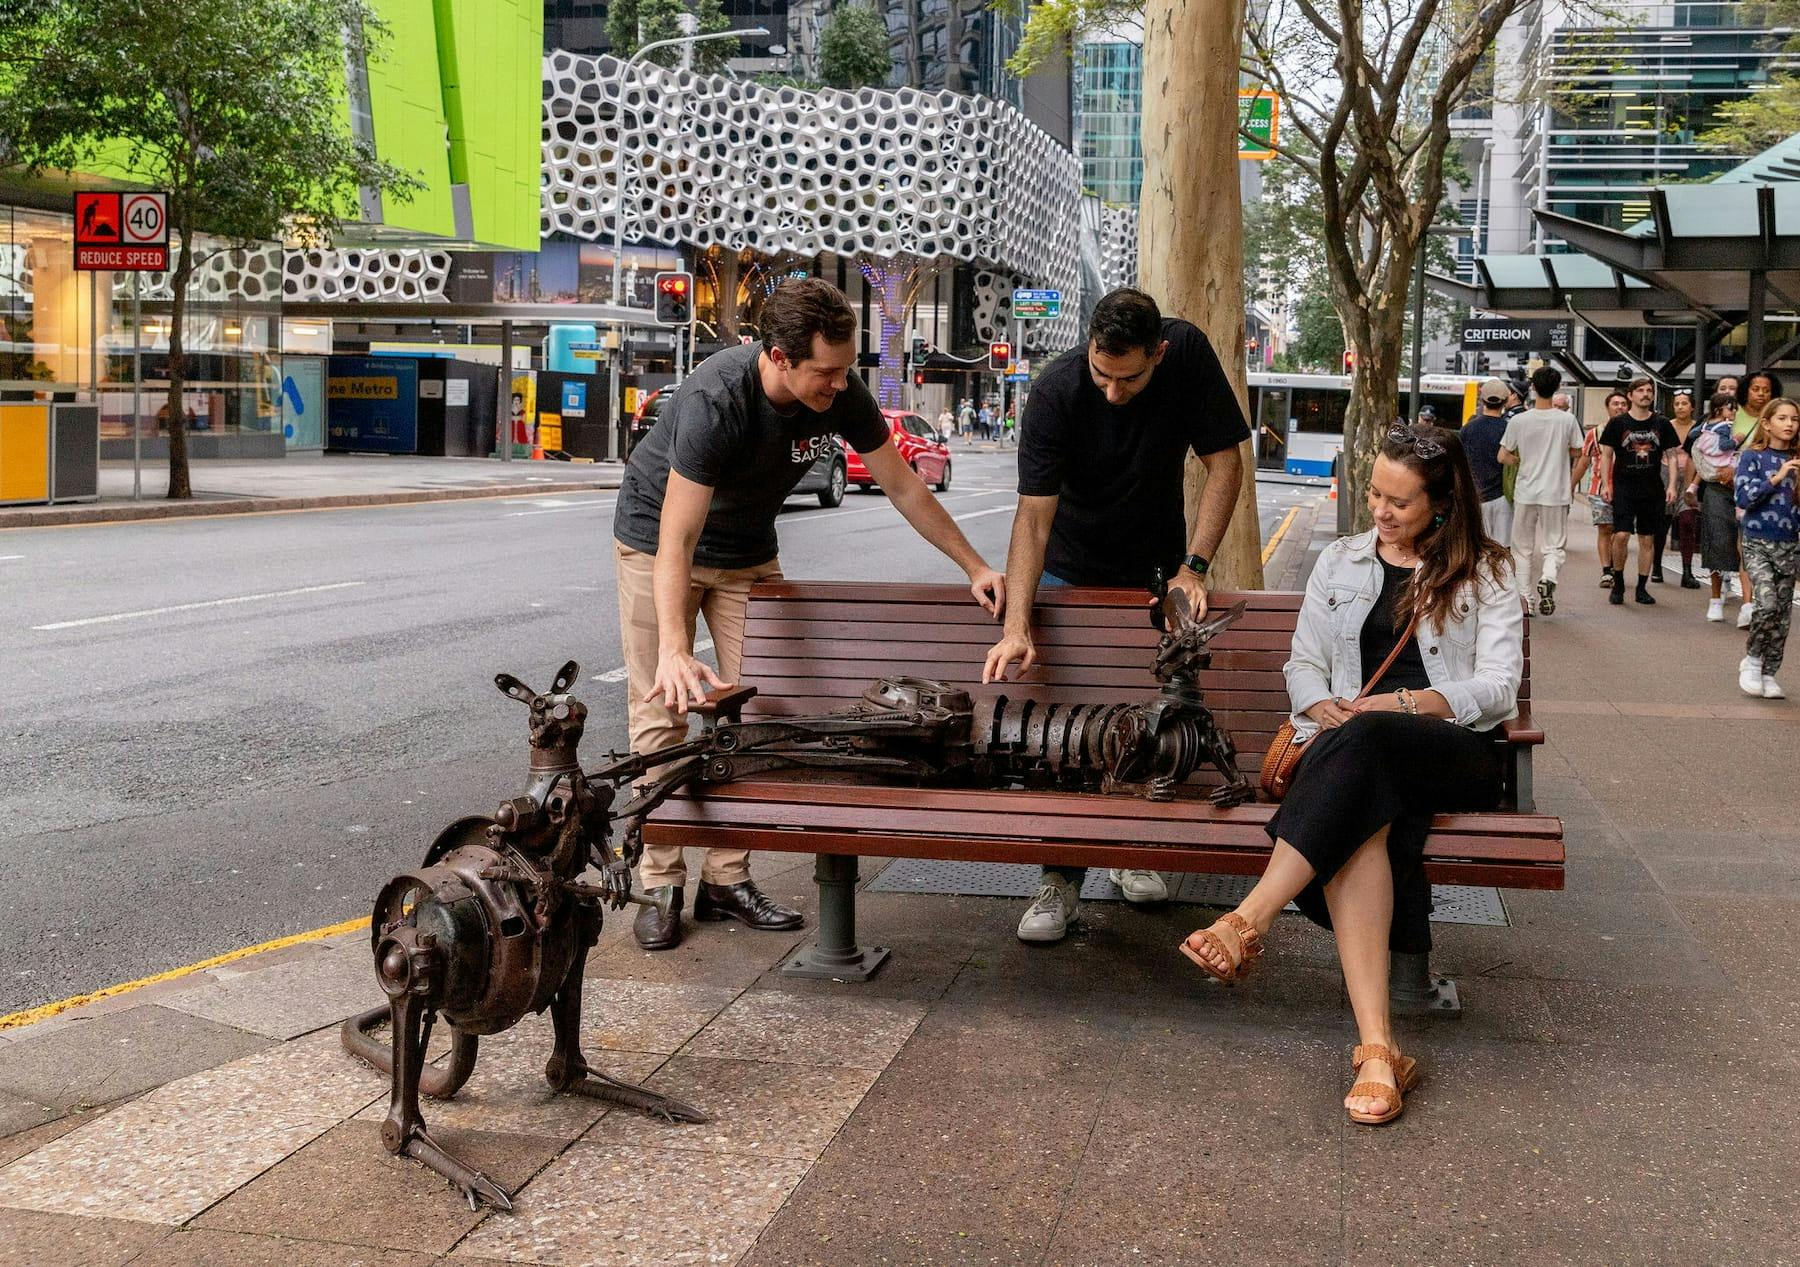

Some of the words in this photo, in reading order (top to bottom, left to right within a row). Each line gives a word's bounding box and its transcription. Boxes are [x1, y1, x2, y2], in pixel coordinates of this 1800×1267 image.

[130, 207, 159, 230] 40
[80, 251, 123, 265] REDUCE
[126, 252, 162, 266] SPEED
[1463, 328, 1531, 340] CRITERION
[351, 382, 392, 395] Metro
